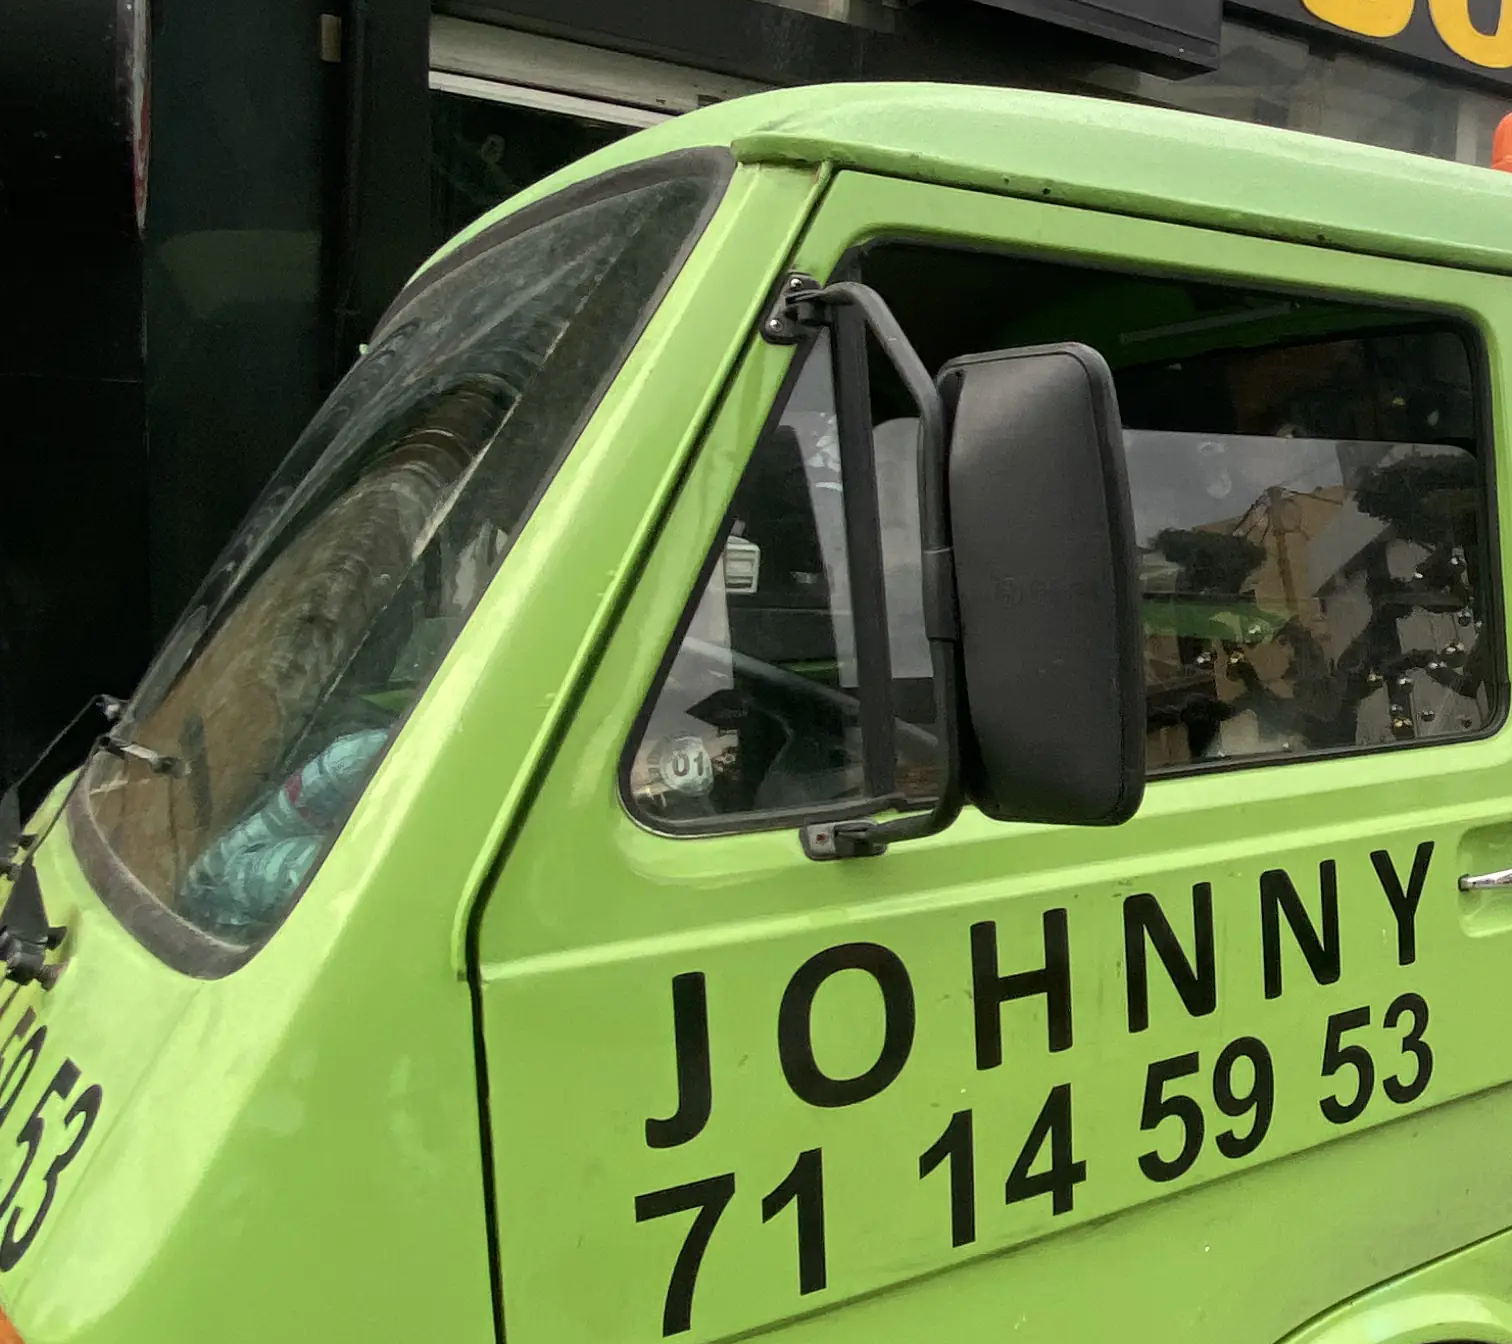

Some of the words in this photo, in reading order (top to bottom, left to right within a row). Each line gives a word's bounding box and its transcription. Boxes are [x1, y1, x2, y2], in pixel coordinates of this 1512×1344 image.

[645, 841, 1435, 1149] JOHNNY
[634, 1147, 827, 1338] 71
[919, 1083, 1086, 1248] 14
[1138, 1036, 1274, 1182] 59
[1319, 993, 1434, 1126] 53
